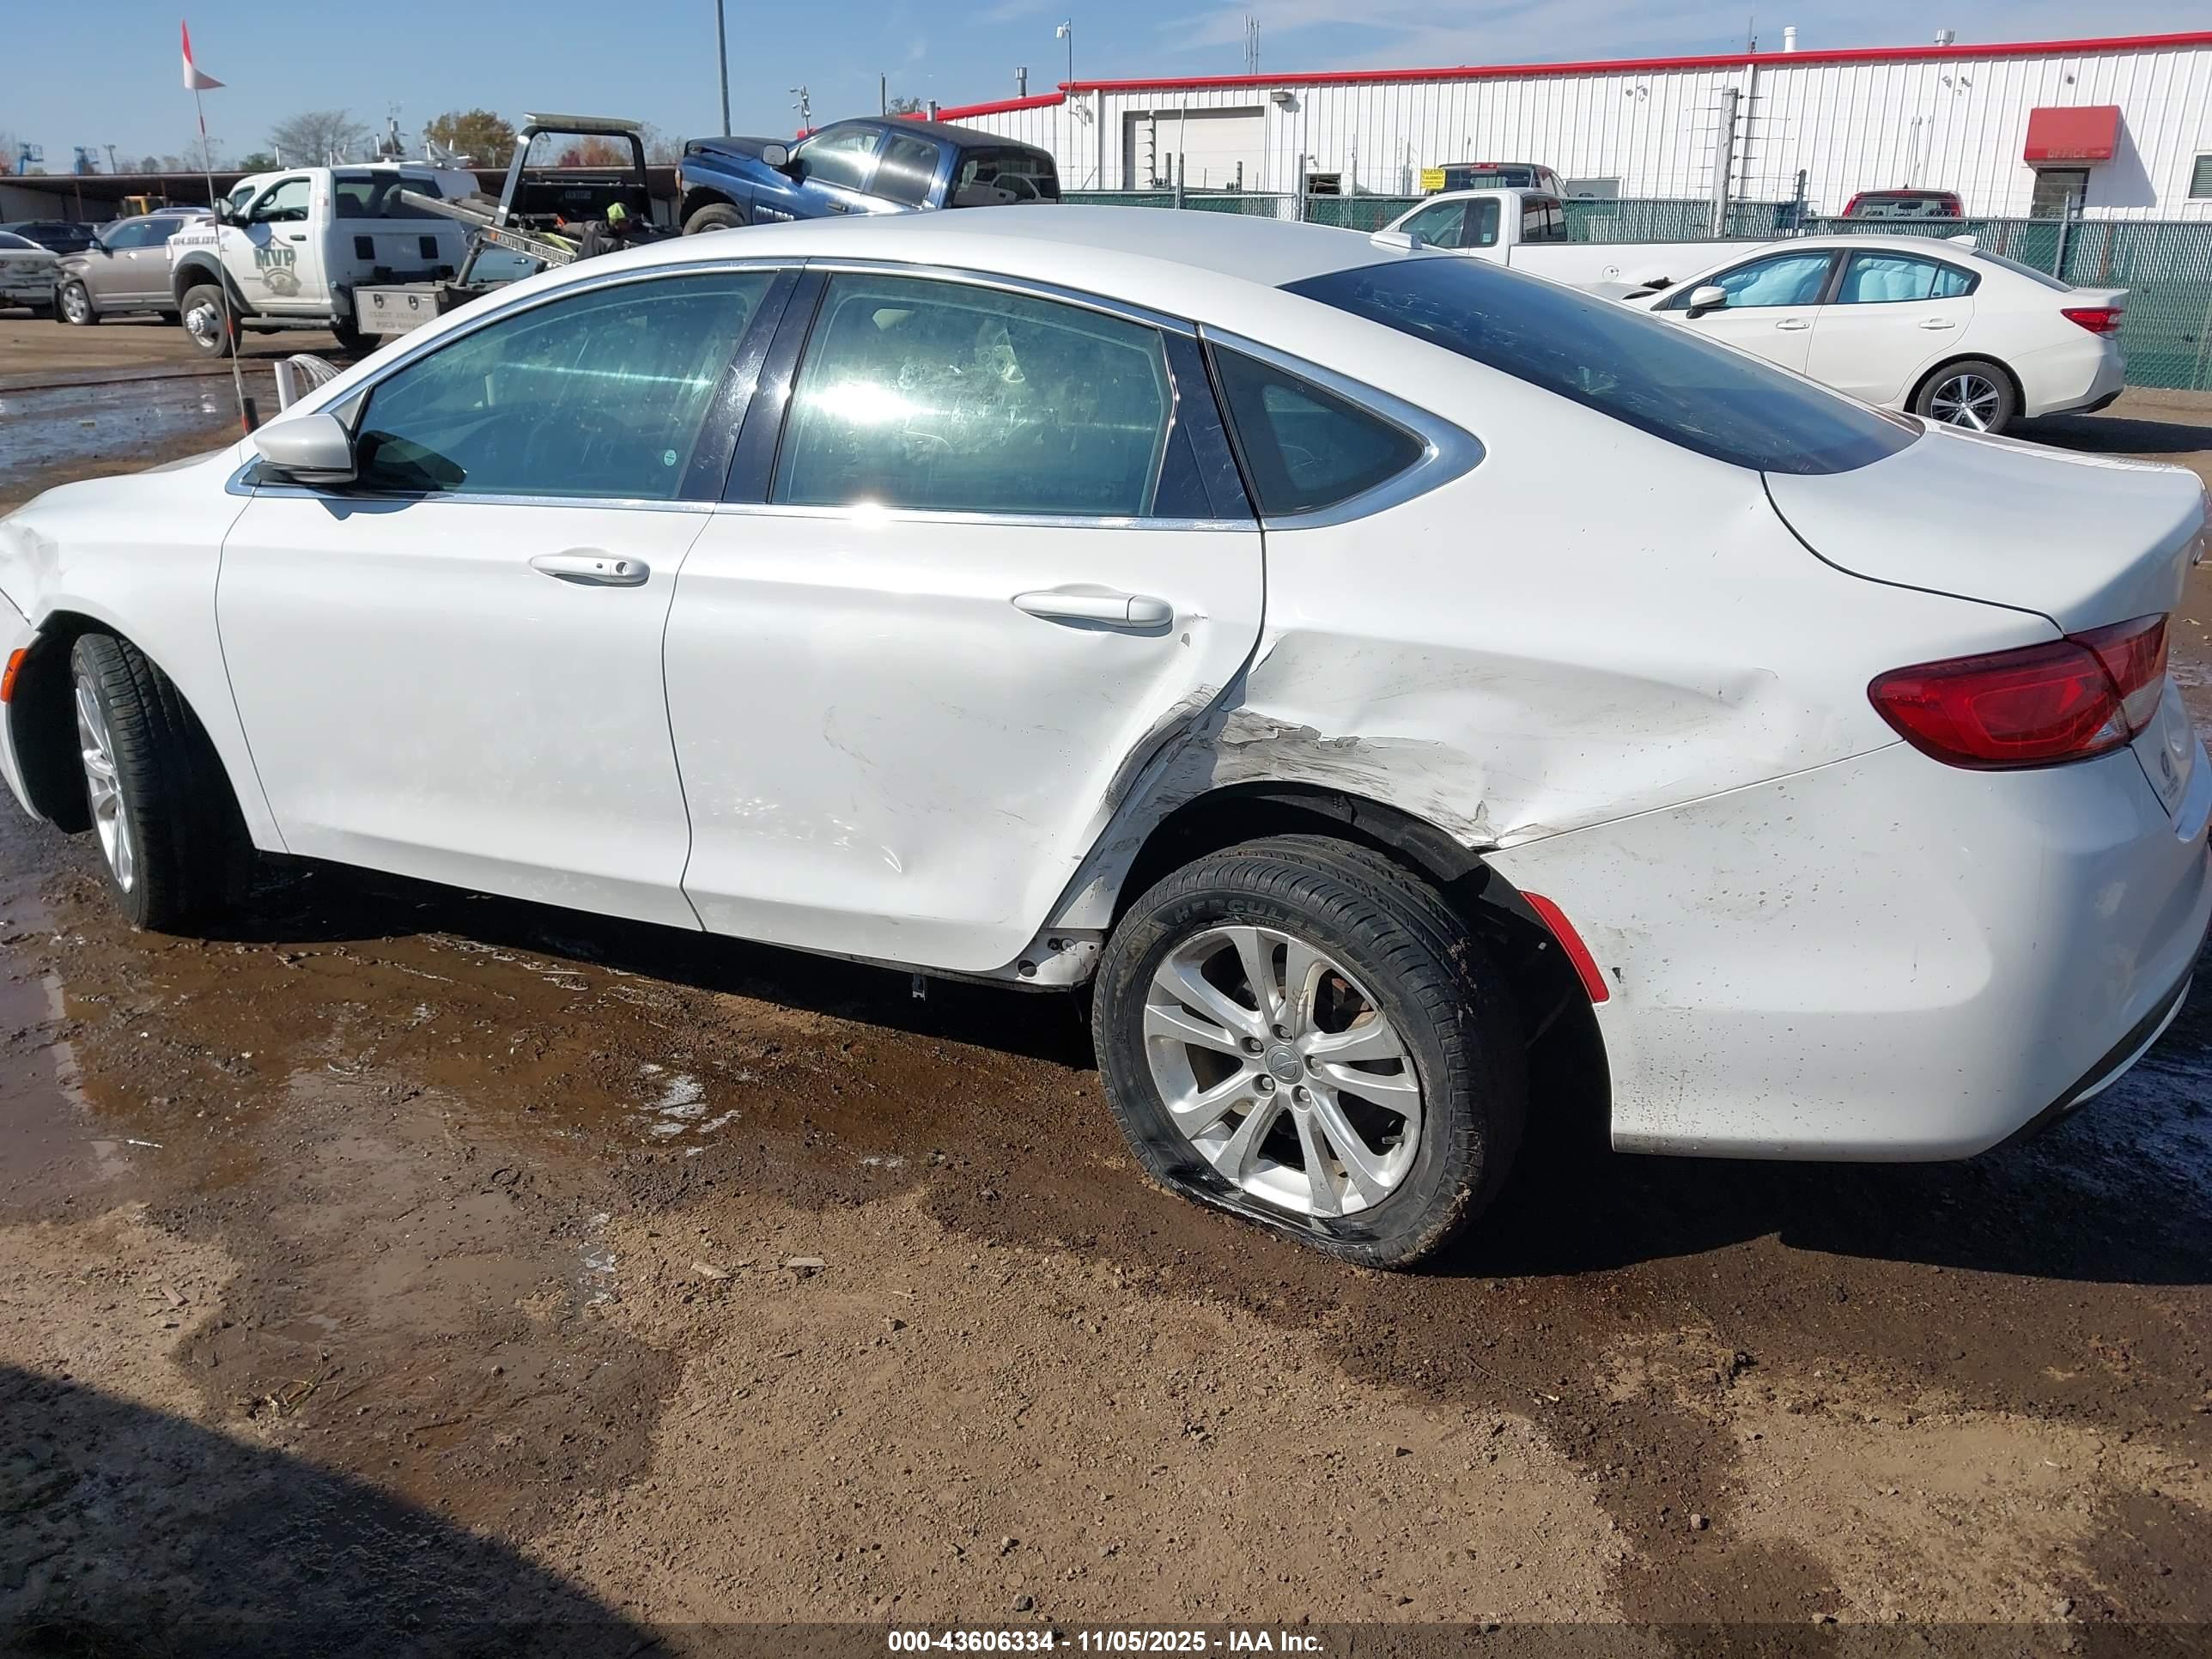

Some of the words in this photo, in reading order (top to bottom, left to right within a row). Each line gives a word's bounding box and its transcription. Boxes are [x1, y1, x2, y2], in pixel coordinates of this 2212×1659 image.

[2047, 147, 2087, 159] OFFICE
[253, 247, 296, 267] MVP
[530, 243, 570, 264] IMPOUND
